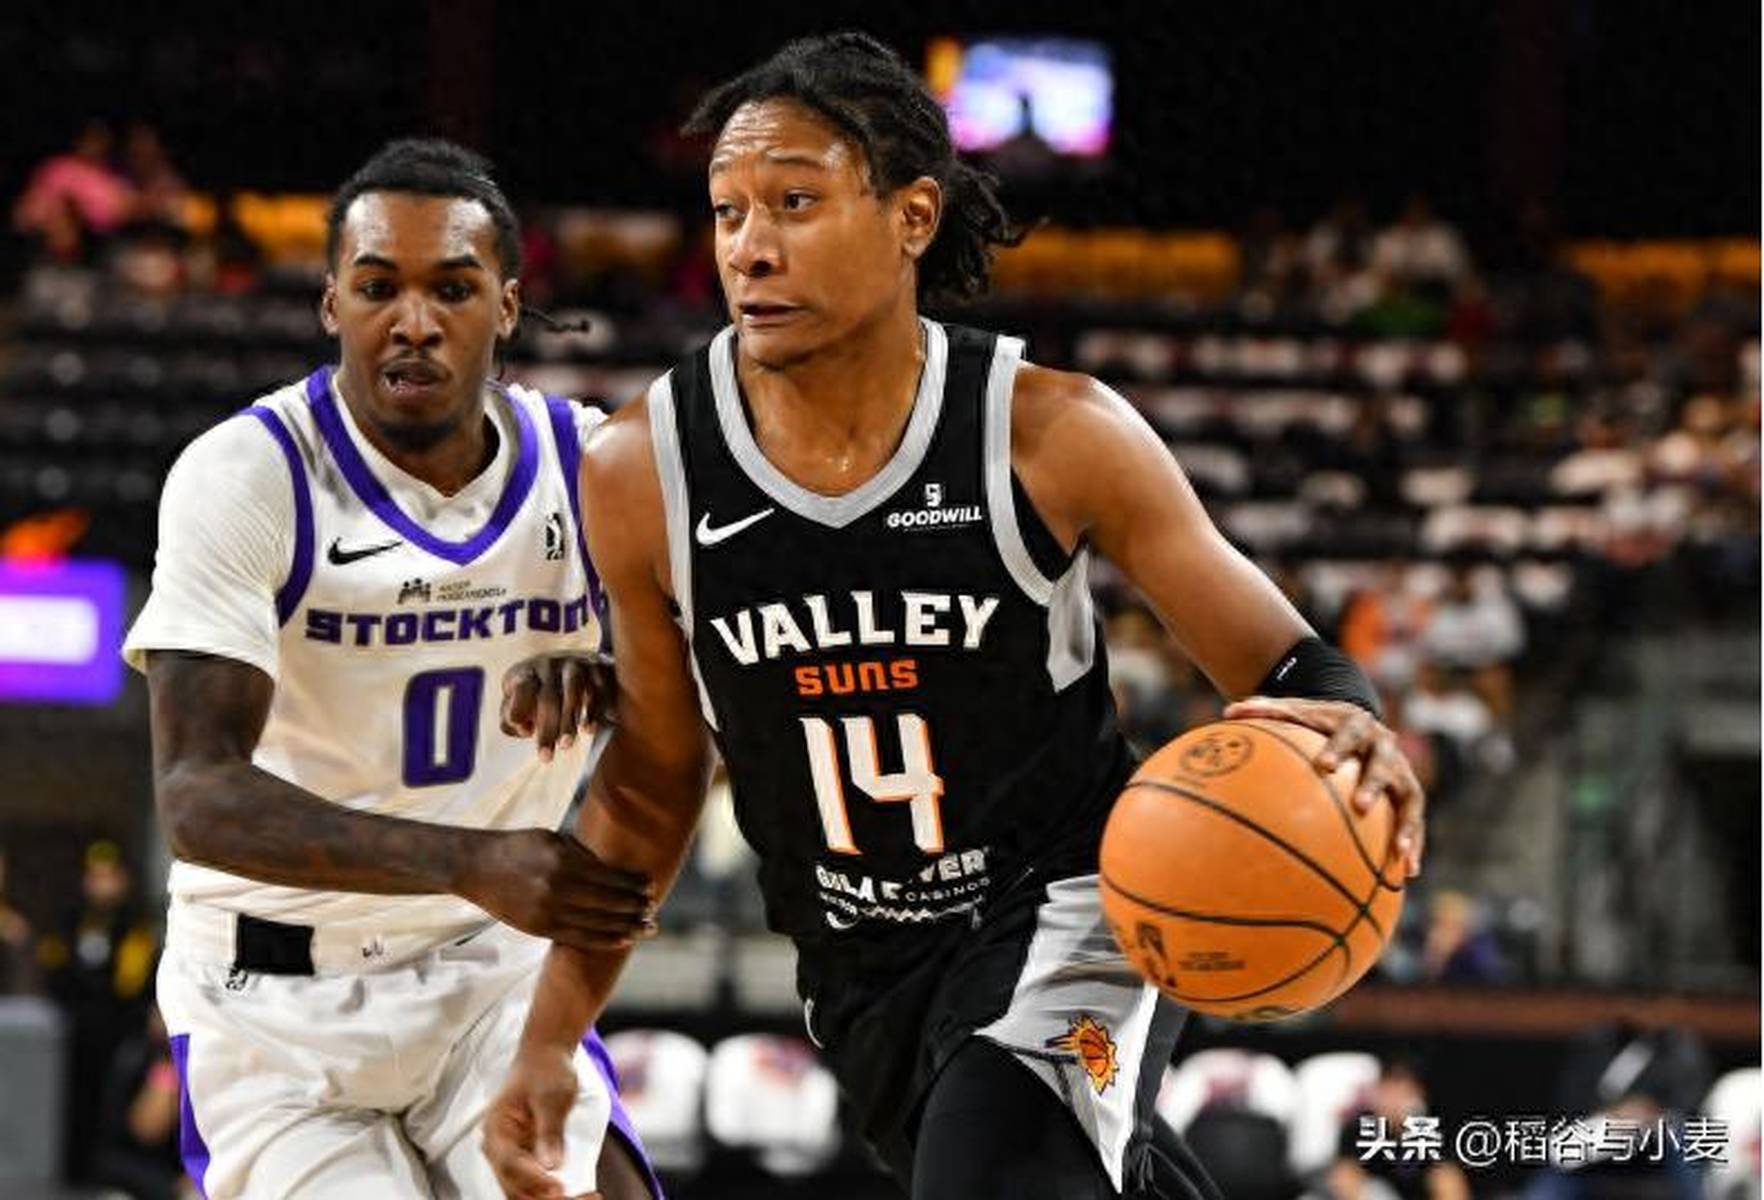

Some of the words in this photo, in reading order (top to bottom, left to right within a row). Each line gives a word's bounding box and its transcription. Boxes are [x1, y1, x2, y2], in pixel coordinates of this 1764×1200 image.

[887, 505, 982, 528] GOODWILL
[710, 590, 999, 666] VALLEY
[402, 666, 485, 788] 0
[799, 713, 944, 855] 14
